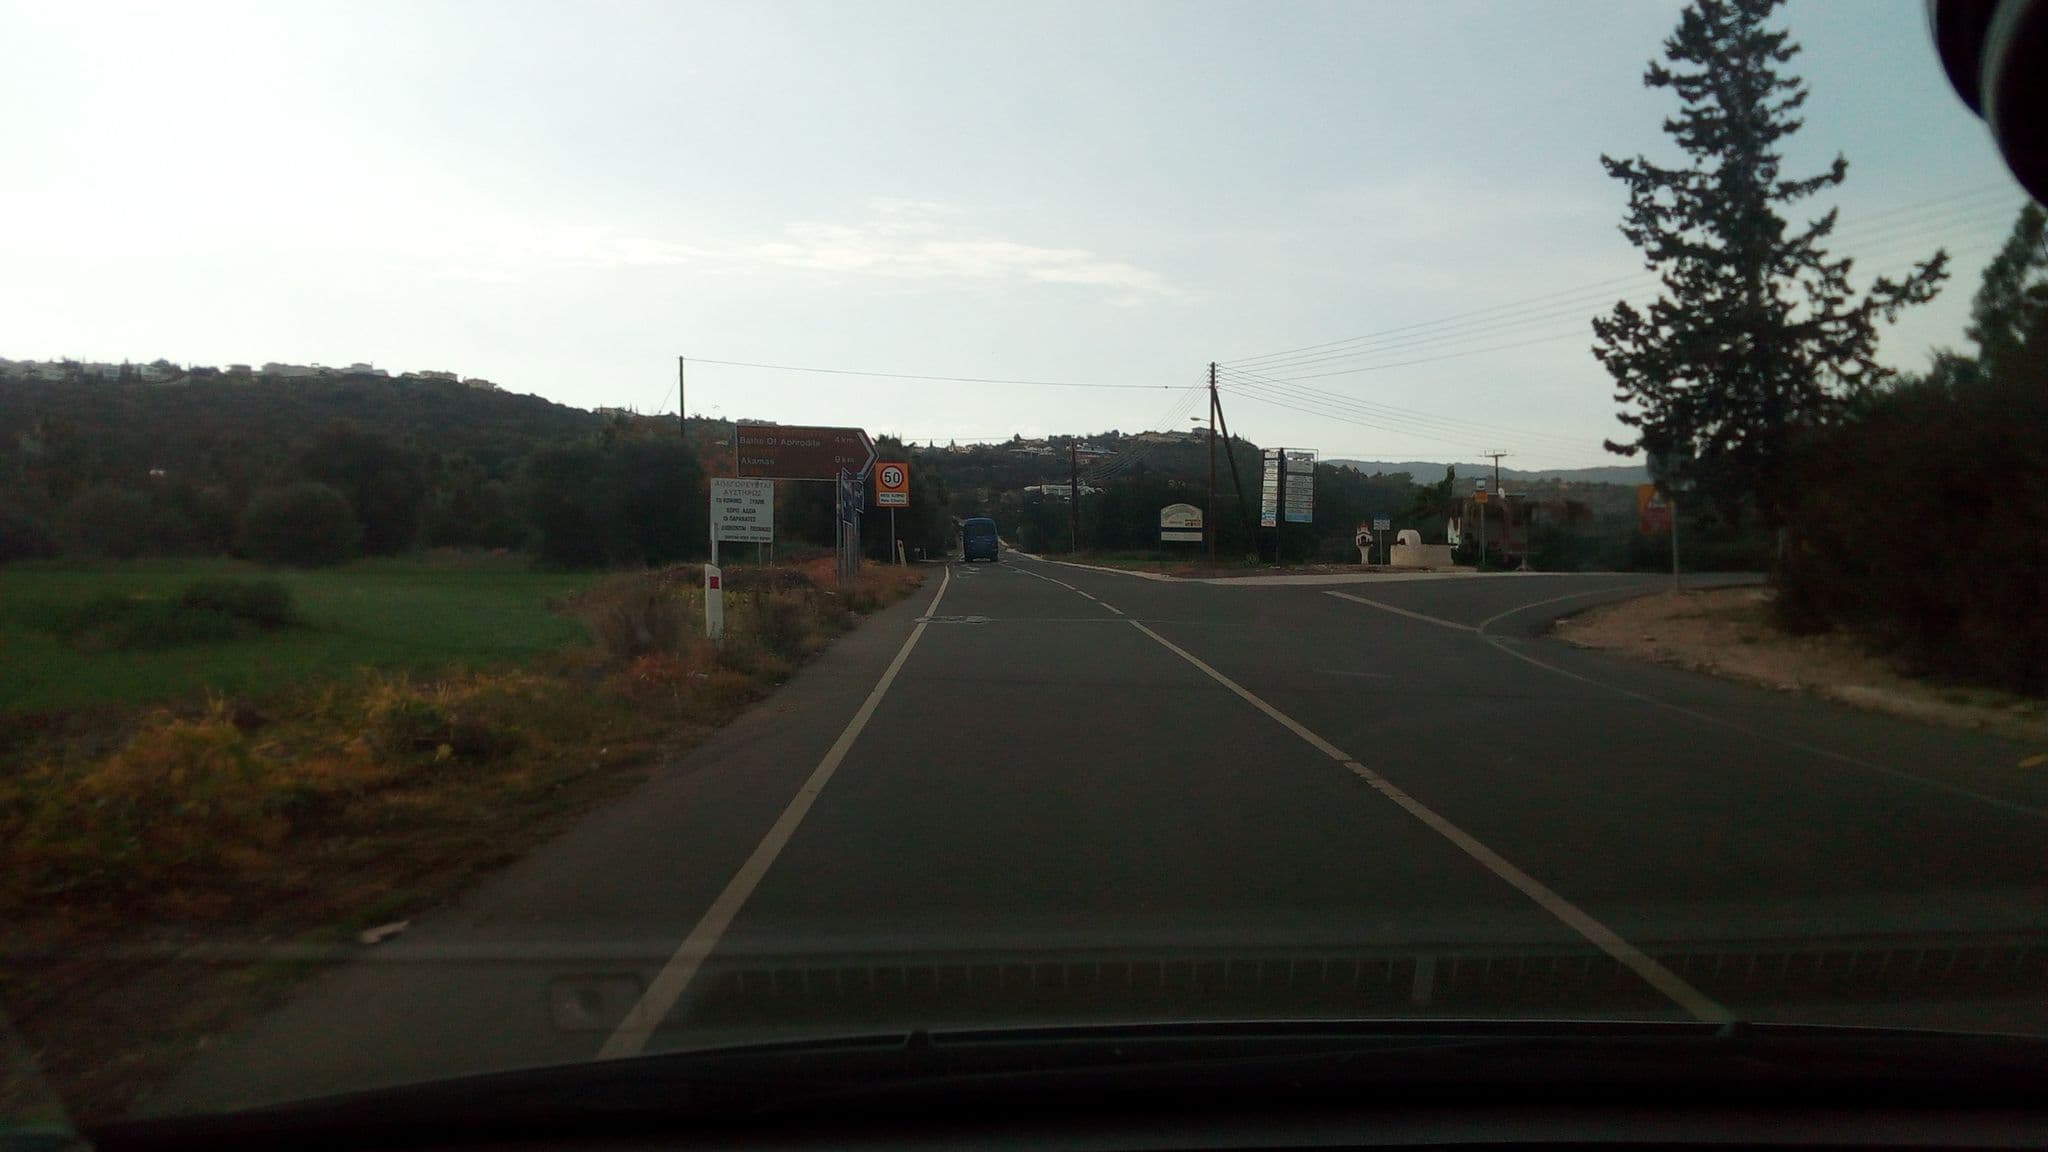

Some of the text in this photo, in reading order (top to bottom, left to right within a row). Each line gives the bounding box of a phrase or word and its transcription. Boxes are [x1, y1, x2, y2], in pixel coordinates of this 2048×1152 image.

[780, 438, 822, 448] Aphrodite
[741, 457, 775, 465] Akamas
[884, 471, 901, 484] 50
